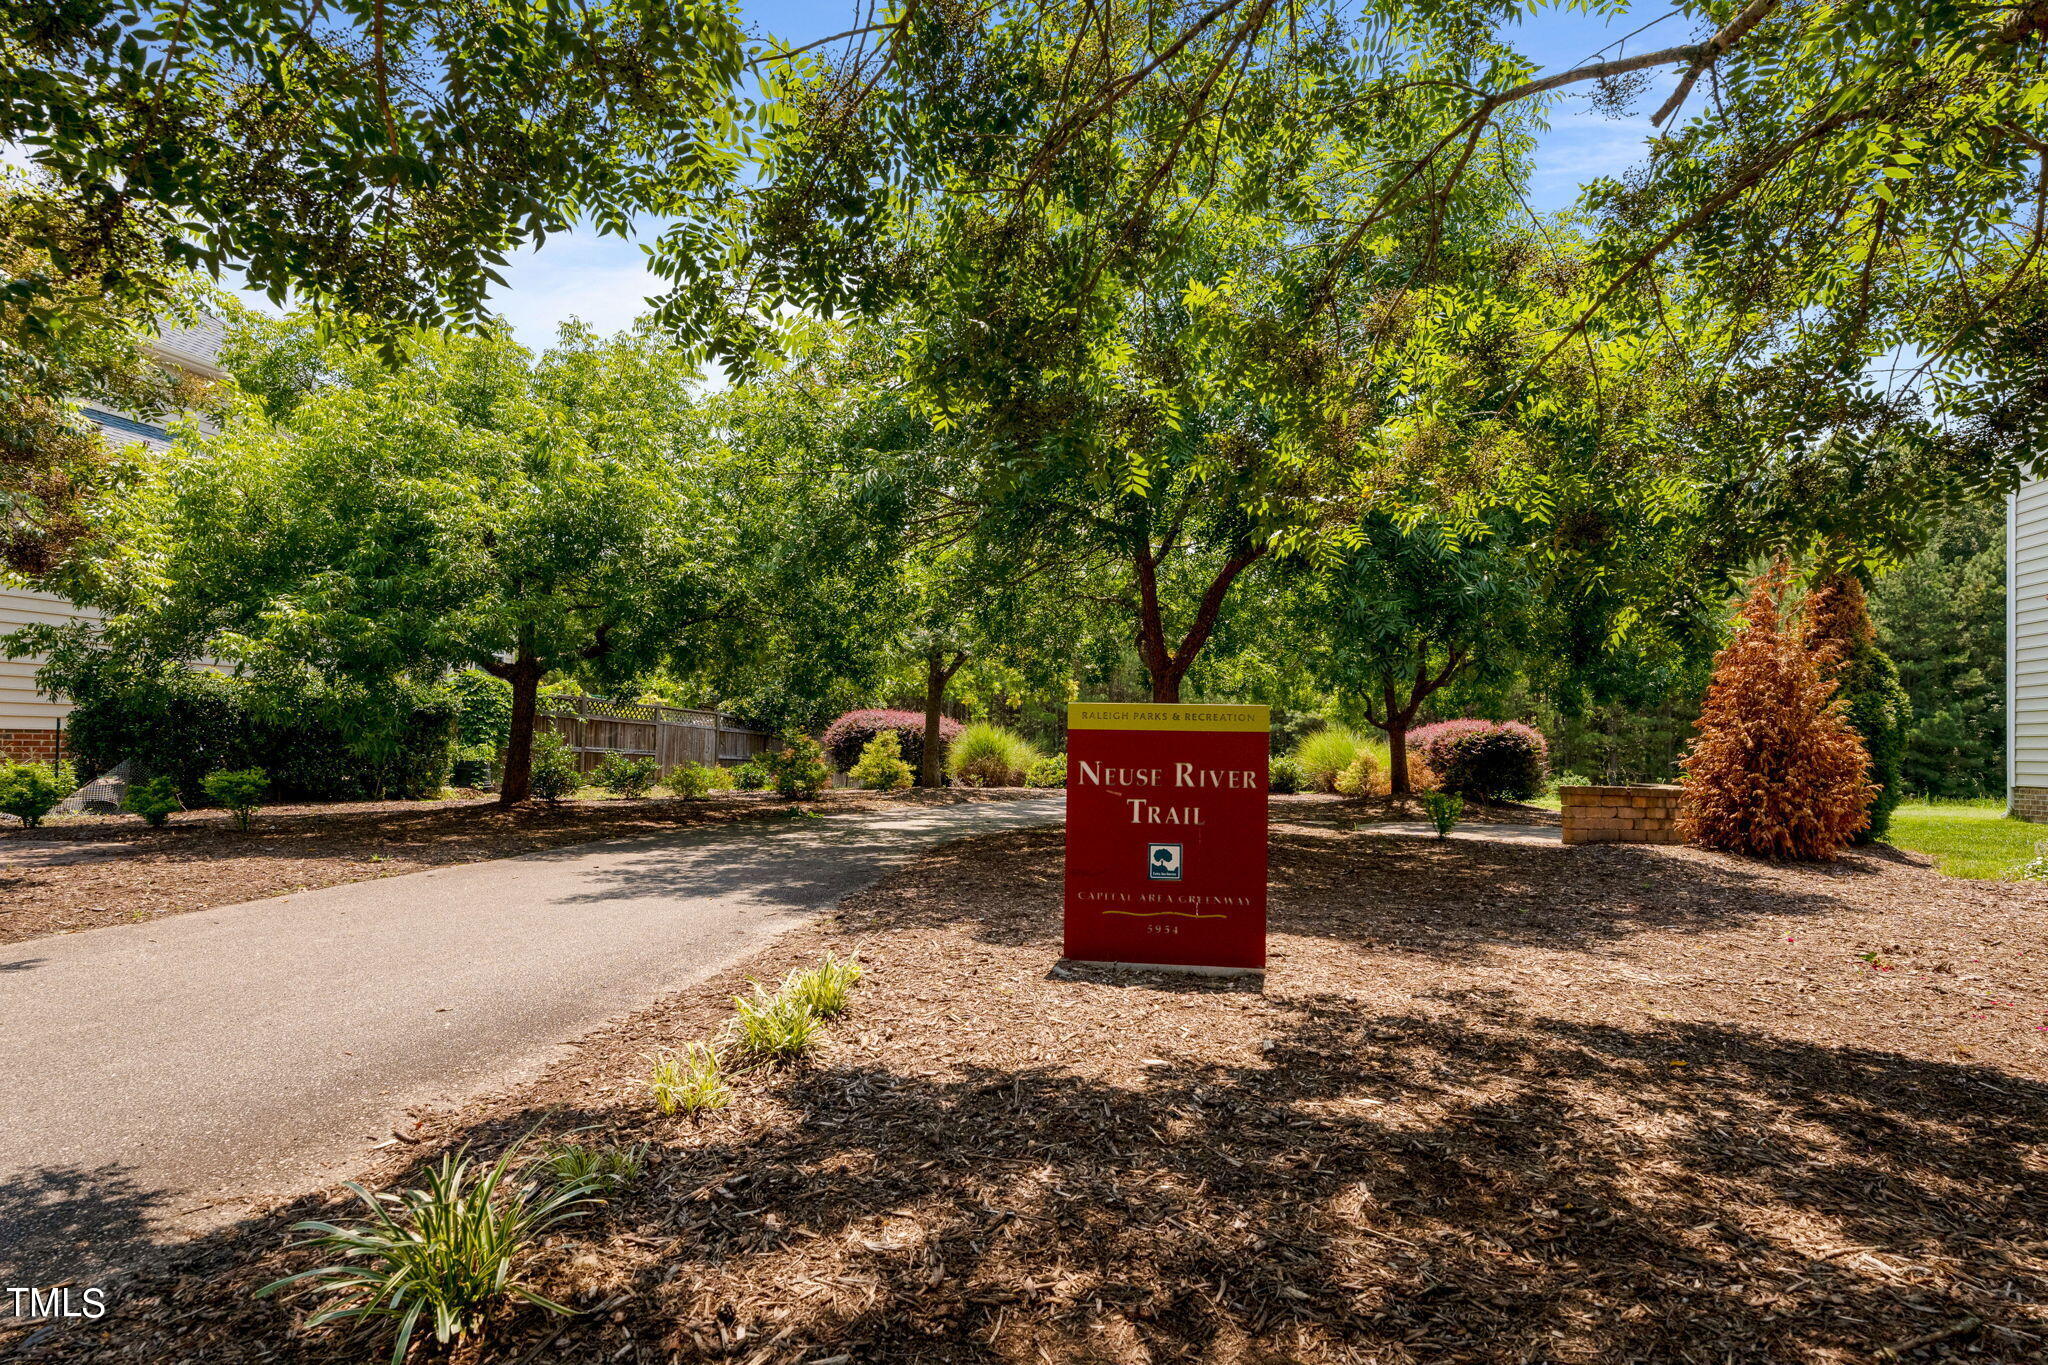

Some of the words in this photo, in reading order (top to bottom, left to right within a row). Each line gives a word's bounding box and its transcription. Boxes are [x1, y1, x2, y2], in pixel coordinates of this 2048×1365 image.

[1081, 711, 1129, 721] RALEIGH
[1133, 712, 1168, 721] PARKS
[1172, 712, 1181, 721] &
[1184, 712, 1256, 722] RECREATION
[1077, 760, 1162, 787] NEUSE
[1174, 762, 1257, 789] RIVER
[1126, 798, 1206, 826] TRAIL
[1077, 891, 1132, 902] CAPITAL
[1139, 893, 1173, 903] AREA
[1178, 894, 1252, 906] GREENWAY
[1146, 924, 1179, 935] 5954
